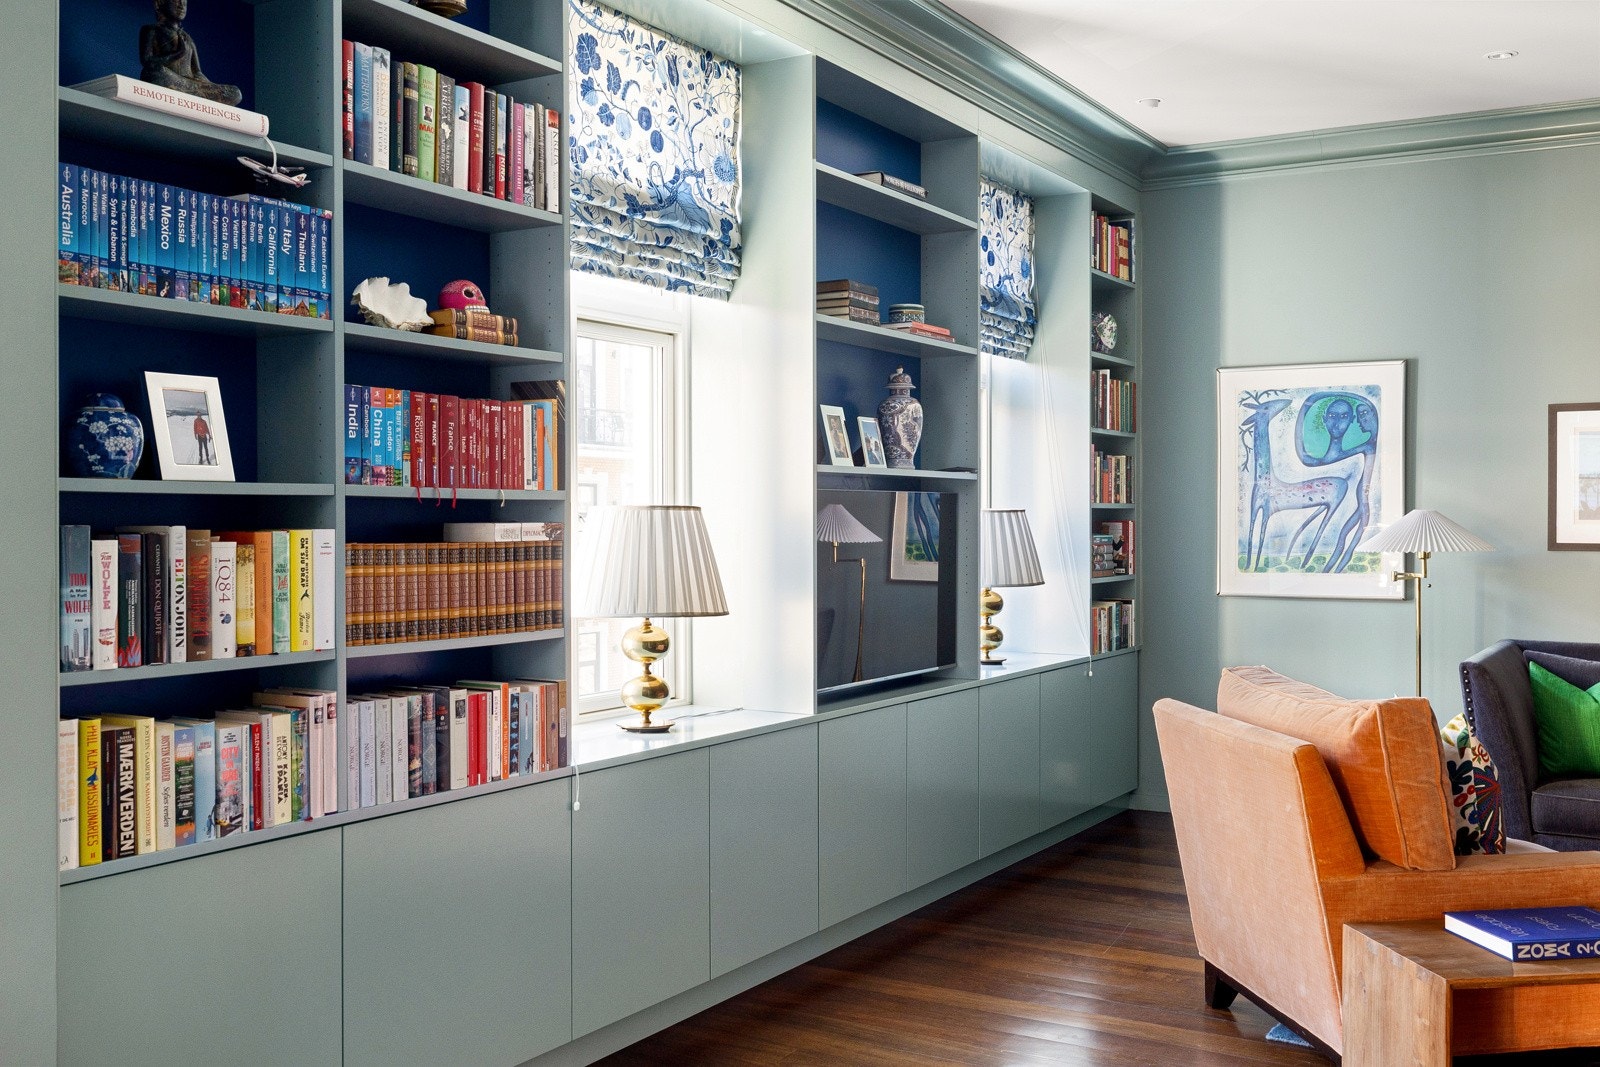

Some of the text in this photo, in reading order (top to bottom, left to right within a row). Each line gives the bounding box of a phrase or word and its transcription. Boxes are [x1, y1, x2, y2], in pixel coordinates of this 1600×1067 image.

[133, 85, 241, 122] REMOTE EXPERIENCES
[62, 185, 73, 245] Australia
[161, 205, 171, 250] Mexico
[178, 209, 186, 243] Russia
[268, 226, 276, 275] California
[281, 229, 292, 255] Italy
[298, 232, 306, 272] Thailand
[349, 404, 357, 438] India
[374, 410, 382, 446] China
[300, 538, 305, 549] OM
[305, 538, 308, 546] EN
[69, 574, 87, 586] TOM
[103, 562, 111, 610] WOLFE
[176, 559, 184, 604] ELTON
[215, 559, 231, 603] 1Q84
[175, 607, 184, 648] JOHN
[161, 736, 170, 757] JOSTEIN
[86, 725, 98, 846] PHIL KLAY MISSIONARIES
[120, 744, 134, 794] MÆRK
[162, 757, 171, 782] GAARDER
[120, 793, 135, 851] VERDEN
[1518, 944, 1570, 959] NOMA
